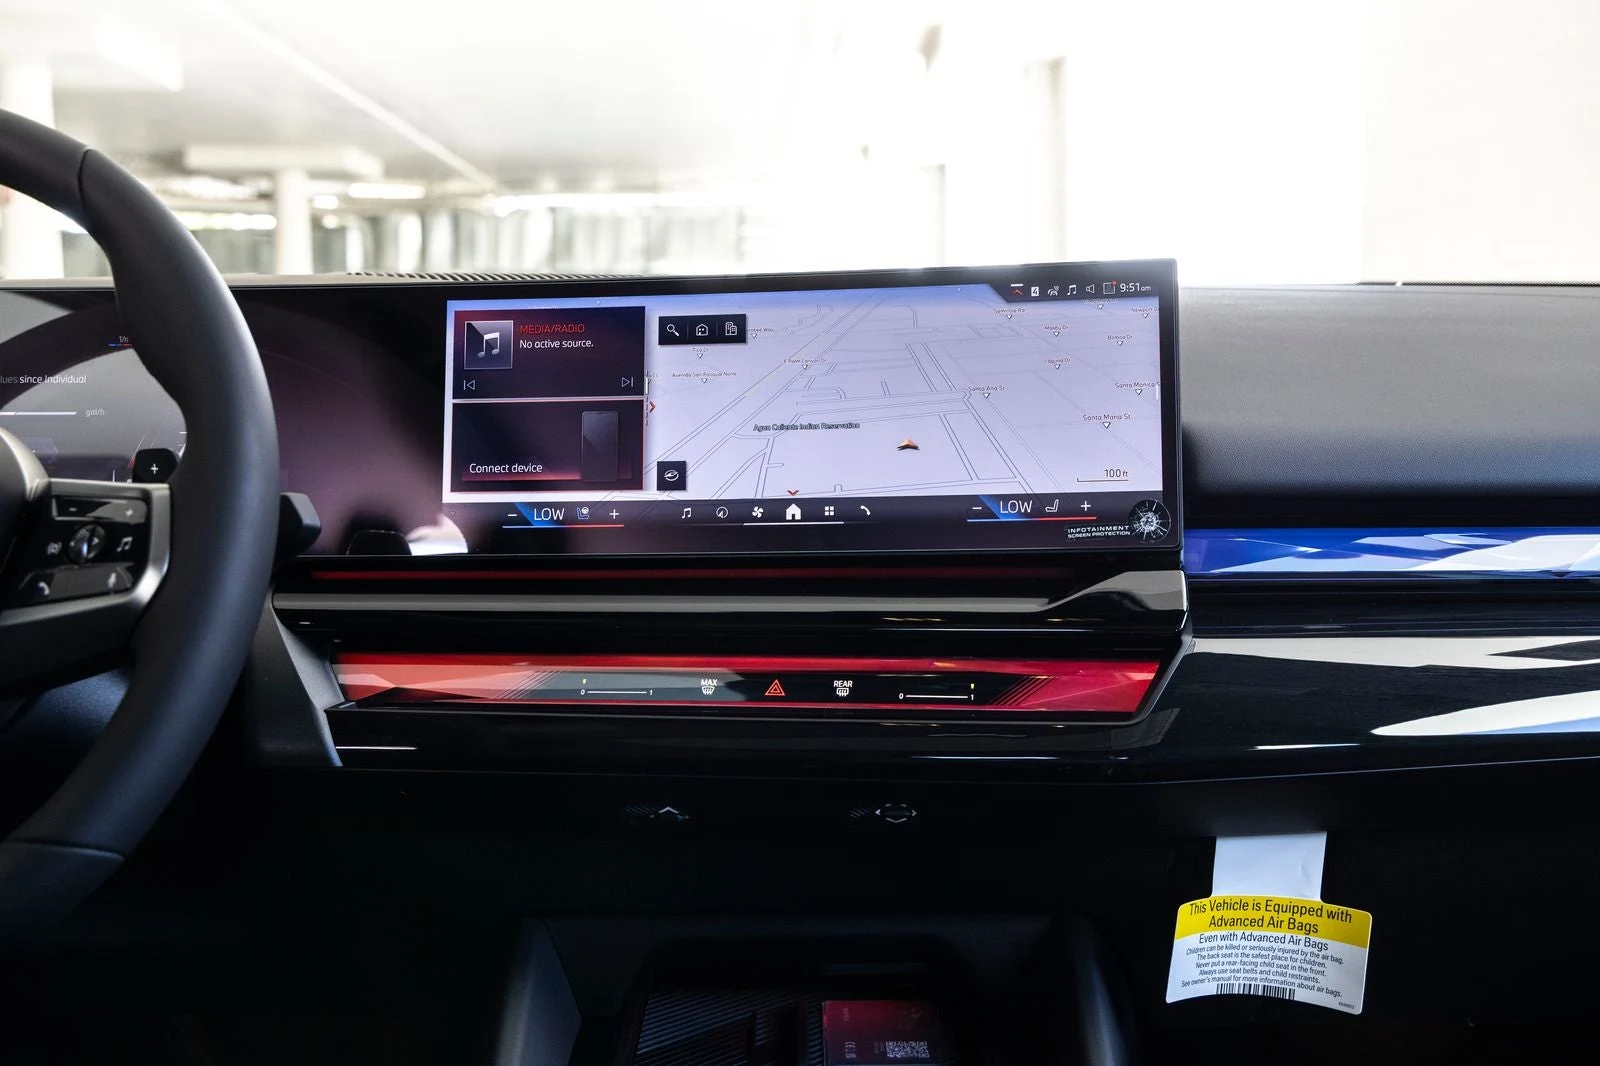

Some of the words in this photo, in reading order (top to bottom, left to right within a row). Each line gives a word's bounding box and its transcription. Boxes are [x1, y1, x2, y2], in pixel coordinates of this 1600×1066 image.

[519, 323, 585, 334] MEDIA/RADIO
[519, 340, 531, 349] No
[533, 339, 559, 349] active
[561, 338, 594, 348] source.
[20, 375, 42, 384] since
[85, 408, 105, 417] gal/h
[753, 424, 771, 432] Agua
[772, 423, 798, 431] Caliente
[800, 422, 820, 430] Indian
[821, 422, 860, 430] Reservation
[469, 463, 509, 473] Connect
[511, 462, 543, 473] device
[1105, 469, 1121, 478] 100
[534, 507, 565, 521] LOW
[1000, 500, 1033, 514] LOW
[1067, 525, 1130, 533] INFOTAINMENT
[1190, 902, 1206, 916] This
[1209, 899, 1249, 912] Vehicle
[1252, 899, 1262, 911] is
[1265, 900, 1323, 918] Equipped
[1326, 908, 1352, 923] with
[1209, 915, 1264, 928] Advanced
[1267, 916, 1284, 929] Air
[1287, 918, 1319, 935] Bags
[1199, 933, 1218, 944] Even
[1220, 931, 1238, 942] with
[1240, 931, 1286, 944] Advanced
[1288, 935, 1302, 946] Air
[1304, 937, 1329, 952] Bags
[1186, 946, 1206, 956] Children
[1225, 943, 1240, 951] killed
[1249, 944, 1277, 953] seriously
[1277, 946, 1300, 956] injured
[1300, 949, 1309, 959] by
[1310, 951, 1320, 959] the
[1321, 953, 1330, 961] air
[1331, 954, 1344, 965] bag.
[1198, 953, 1206, 961] The
[1207, 951, 1220, 960] back
[1221, 951, 1233, 959] seat
[1240, 951, 1250, 959] the
[1251, 951, 1270, 961] safest
[1271, 952, 1289, 962] place
[1290, 955, 1299, 963] for
[1300, 957, 1327, 968] children.
[1196, 960, 1210, 969] Never
[1211, 959, 1220, 968] put
[1226, 959, 1259, 968] rear-facing
[1260, 959, 1275, 968] child
[1276, 961, 1289, 970] seat
[1298, 965, 1308, 974] the
[1309, 967, 1327, 977] front.
[1199, 968, 1217, 977] Always
[1229, 967, 1241, 975] seat
[1243, 967, 1257, 975] belts
[1259, 968, 1271, 977] and
[1272, 970, 1287, 979] child
[1289, 973, 1320, 984] restraints.
[1191, 977, 1210, 986] owner's
[1211, 975, 1232, 983] manual
[1259, 977, 1295, 987] information
[1297, 981, 1315, 991] about
[1326, 988, 1343, 998] bags.
